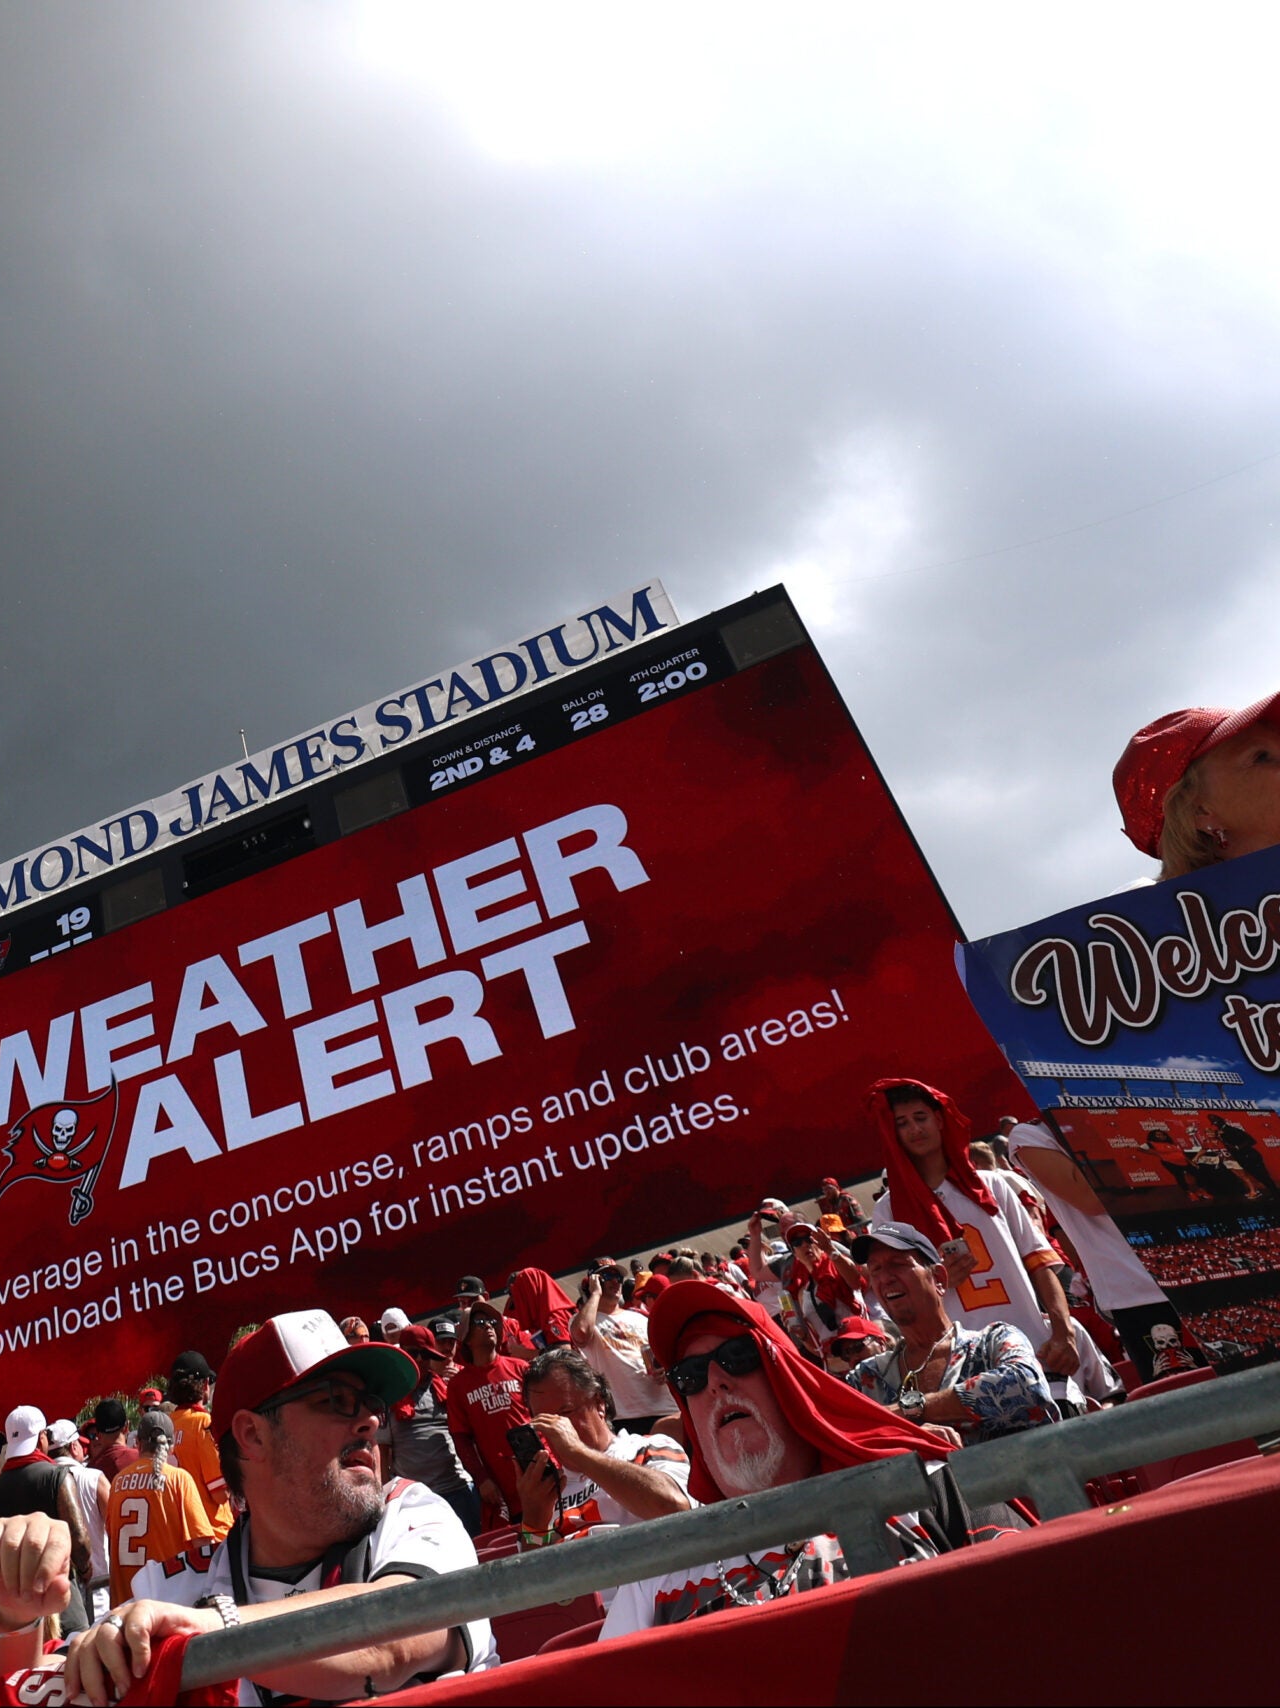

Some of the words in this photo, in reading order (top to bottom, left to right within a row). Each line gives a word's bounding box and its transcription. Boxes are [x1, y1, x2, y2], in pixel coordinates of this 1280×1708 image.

[629, 668, 650, 684] 4TH
[649, 648, 700, 675] QUARTER
[637, 661, 708, 703] 2:00
[169, 716, 367, 838] JAMES
[375, 586, 668, 749] STADIUM
[562, 695, 588, 712] BALL
[588, 688, 605, 702] ON
[570, 703, 609, 732] 28
[429, 756, 484, 791] 2ND
[489, 746, 513, 766] &
[516, 734, 537, 752] 4
[432, 747, 464, 768] DOWN
[473, 723, 523, 750] DISTANCE
[56, 906, 91, 936] 19
[118, 920, 592, 1190] ALERT
[1062, 1095, 1146, 1108] RAYMOND
[1146, 1097, 1193, 1109] JAMES
[1197, 1099, 1256, 1111] STADIUM
[109, 1236, 140, 1268] in
[145, 1218, 200, 1256] the
[209, 1153, 405, 1235] concourse,
[412, 1106, 533, 1168] ramps
[541, 1069, 616, 1123] and
[623, 1041, 711, 1094] club
[720, 989, 850, 1061] areas!
[129, 1275, 184, 1313] the
[192, 1244, 280, 1293] Bucs
[289, 1218, 362, 1264] App
[369, 1196, 420, 1236] for
[427, 1146, 563, 1217] instant
[569, 1094, 750, 1170] updates.
[466, 1383, 495, 1405] RAISE
[501, 1379, 521, 1393] THE
[481, 1393, 512, 1412] FLAGS
[118, 1497, 149, 1566] 2
